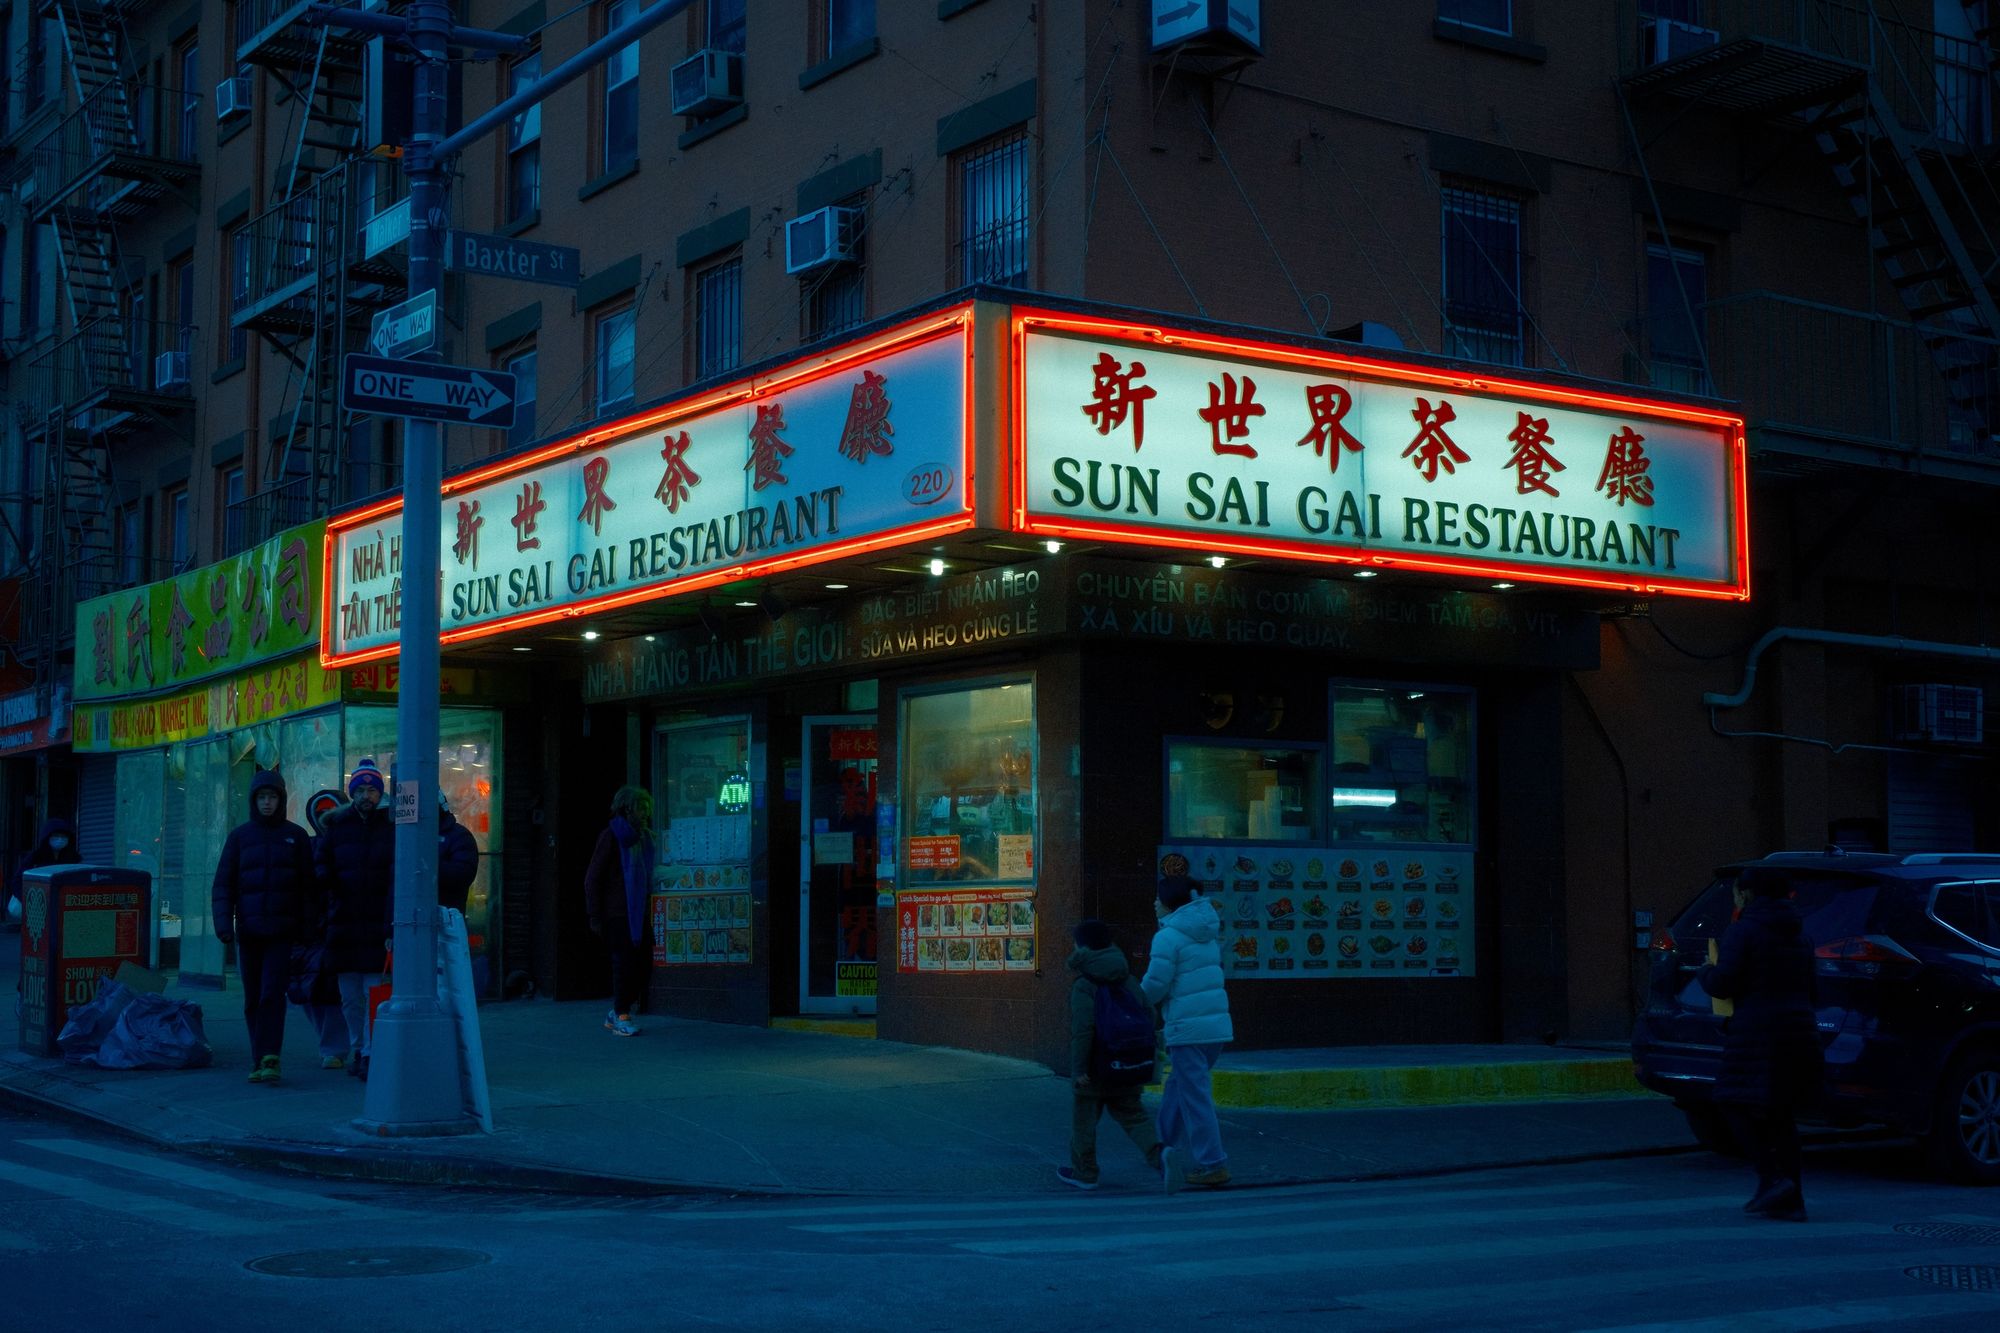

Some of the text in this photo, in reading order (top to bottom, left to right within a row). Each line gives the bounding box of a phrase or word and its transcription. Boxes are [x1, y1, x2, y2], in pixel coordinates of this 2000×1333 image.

[371, 214, 402, 249] Walker
[464, 237, 564, 277] Baxter St
[378, 308, 431, 348] ONE WAY
[360, 373, 496, 409] ONE WAY
[1082, 352, 1655, 508] 新世界茶餐廳
[452, 370, 895, 572] 新世界茶餐廳
[911, 470, 943, 498] 220
[1053, 457, 1680, 570] SUN SAI GAI RESTAURANT
[352, 529, 386, 584] NHÀ
[452, 574, 501, 621] SUN
[508, 560, 553, 608] SAI
[567, 545, 617, 594] GAI
[628, 486, 843, 580] RESTAURANT
[1001, 570, 1040, 599] HEO
[1076, 571, 1186, 604] CHUYÊN
[341, 590, 371, 641] TÂN
[1226, 617, 1277, 643] HEO
[923, 624, 958, 650] HEO
[586, 651, 627, 698] NHÀ
[696, 632, 737, 682] TÂN
[159, 697, 190, 734] MARKET
[719, 782, 749, 804] ATM
[913, 895, 930, 903] Special
[23, 975, 46, 1008] LOVE
[65, 967, 95, 981] SHOW
[64, 980, 100, 1005] LOV
